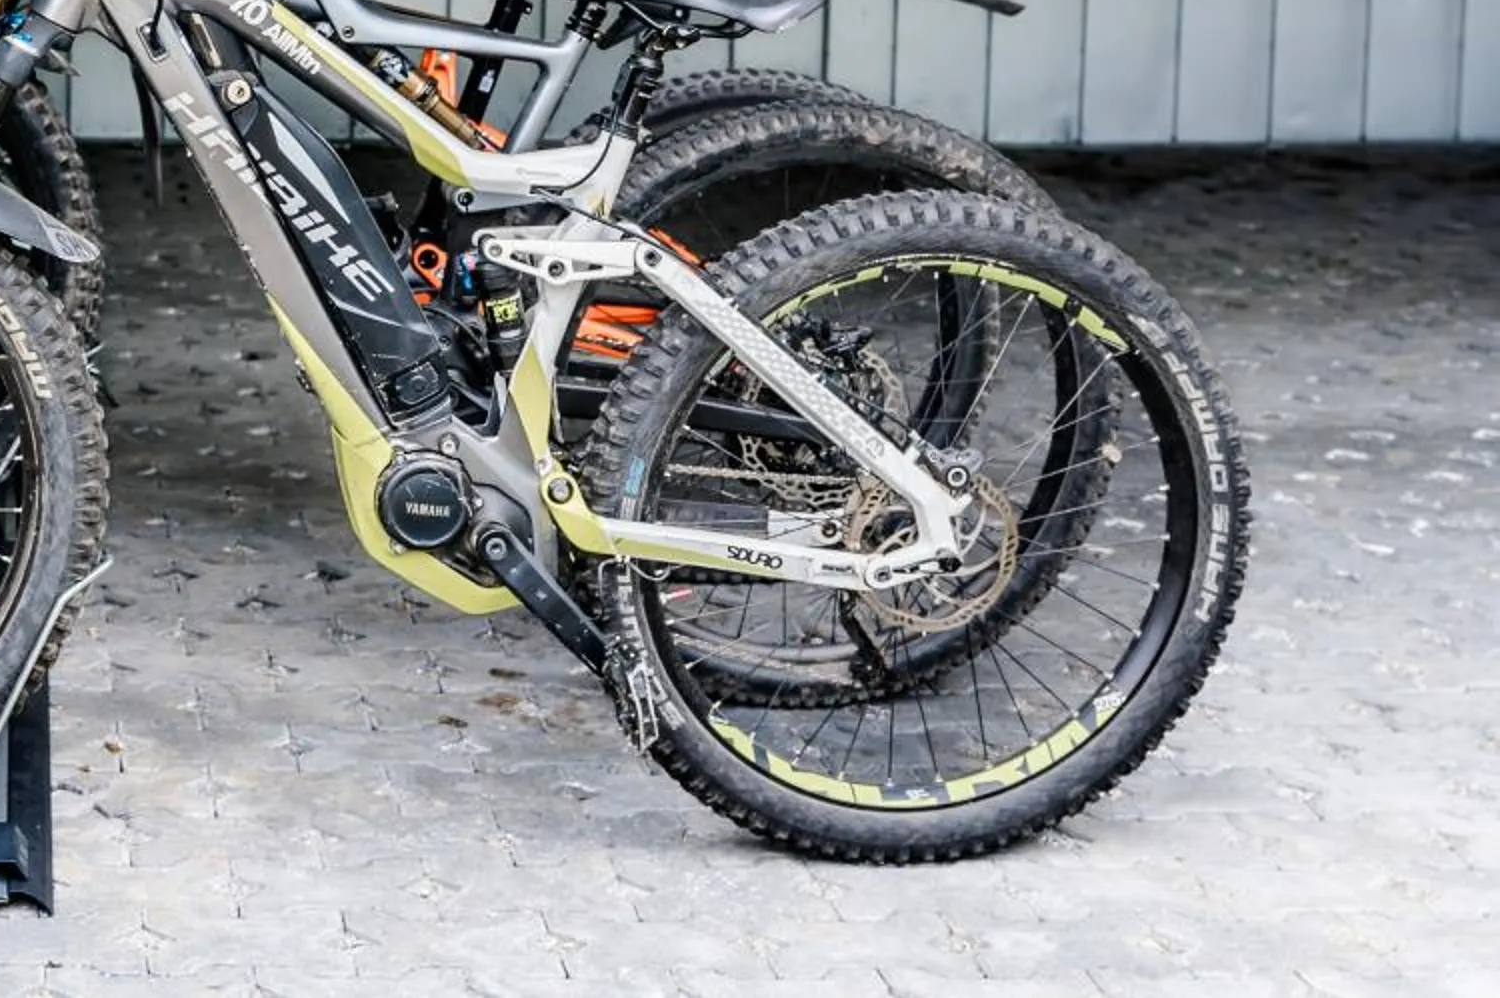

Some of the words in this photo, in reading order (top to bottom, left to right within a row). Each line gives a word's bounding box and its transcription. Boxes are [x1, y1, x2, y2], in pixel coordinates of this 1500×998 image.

[1162, 350, 1231, 493] DAMPF
[405, 501, 451, 518] YAMAHA
[1195, 501, 1230, 622] HANS
